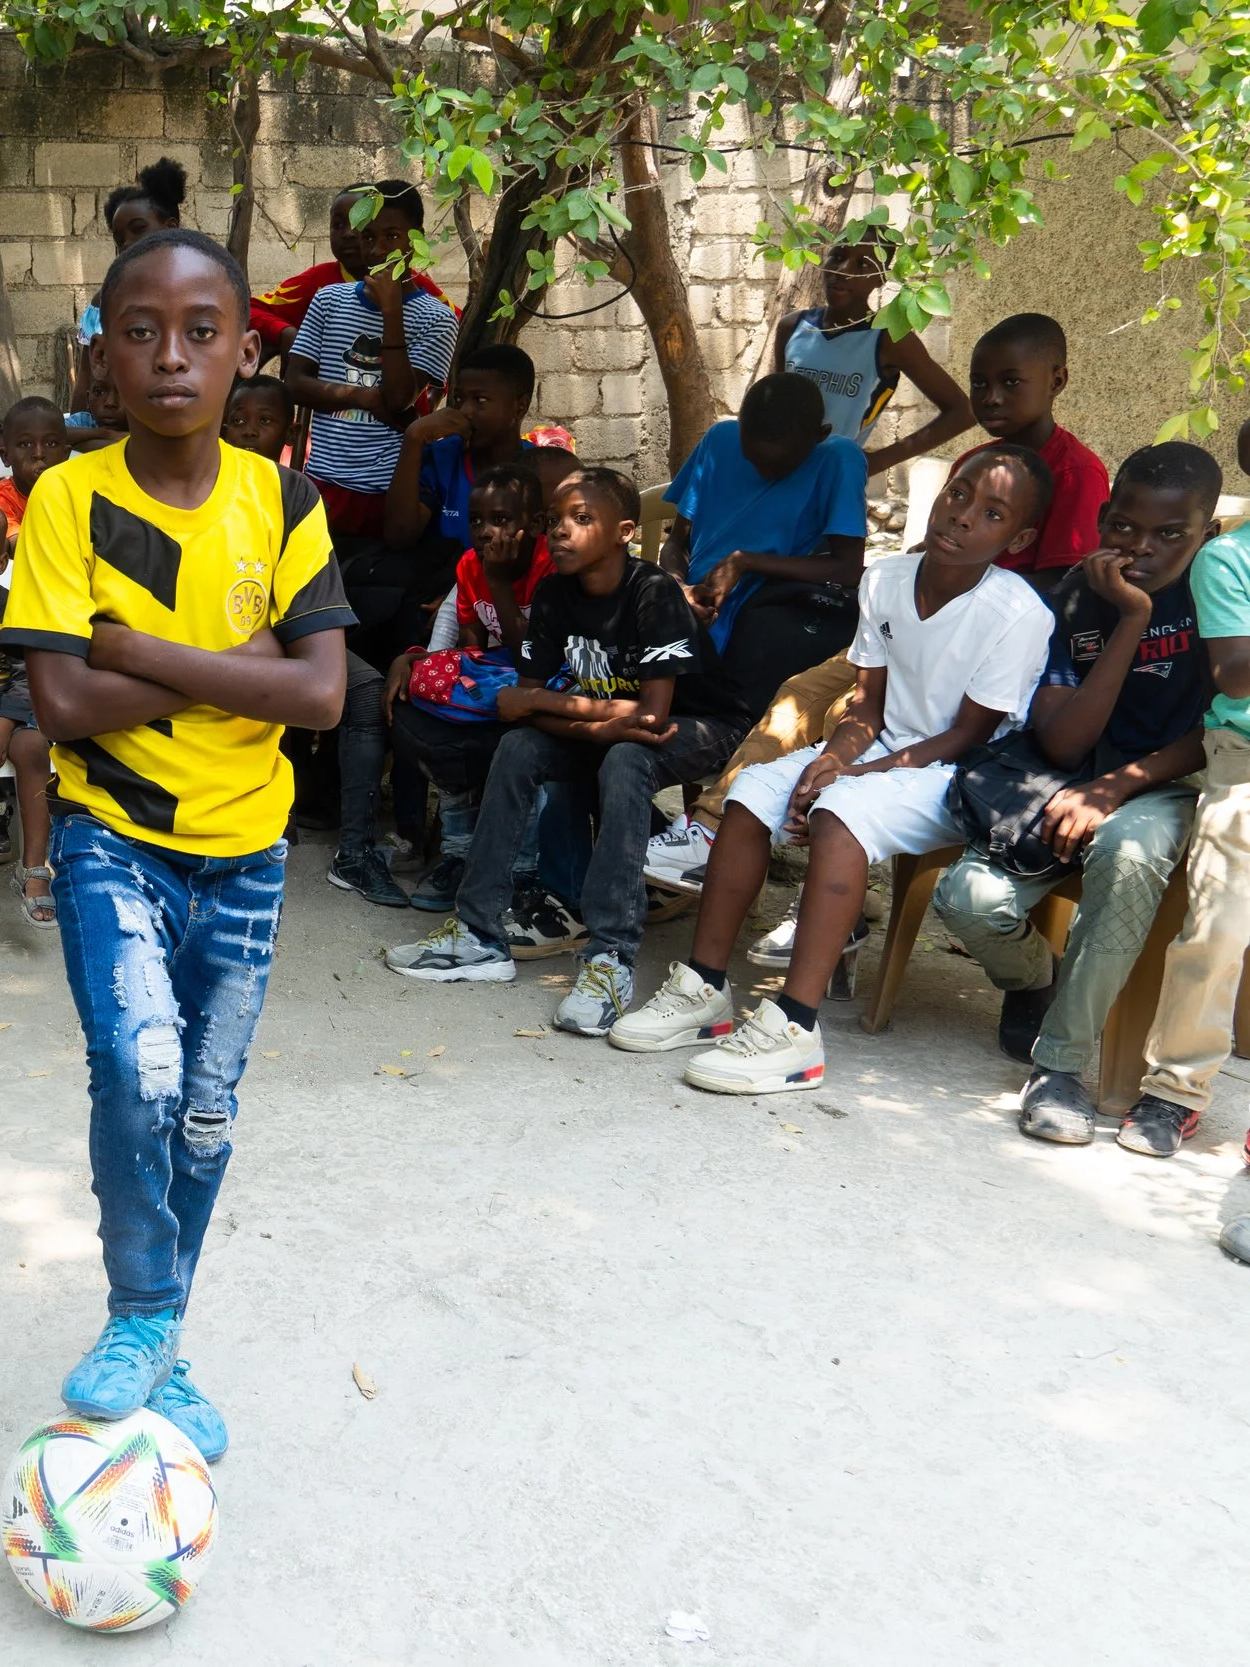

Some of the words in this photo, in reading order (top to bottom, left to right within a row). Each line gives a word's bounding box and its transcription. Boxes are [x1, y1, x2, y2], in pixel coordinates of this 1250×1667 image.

[233, 586, 263, 615] BVB
[240, 615, 251, 627] 09
[110, 1526, 135, 1538] adidas
